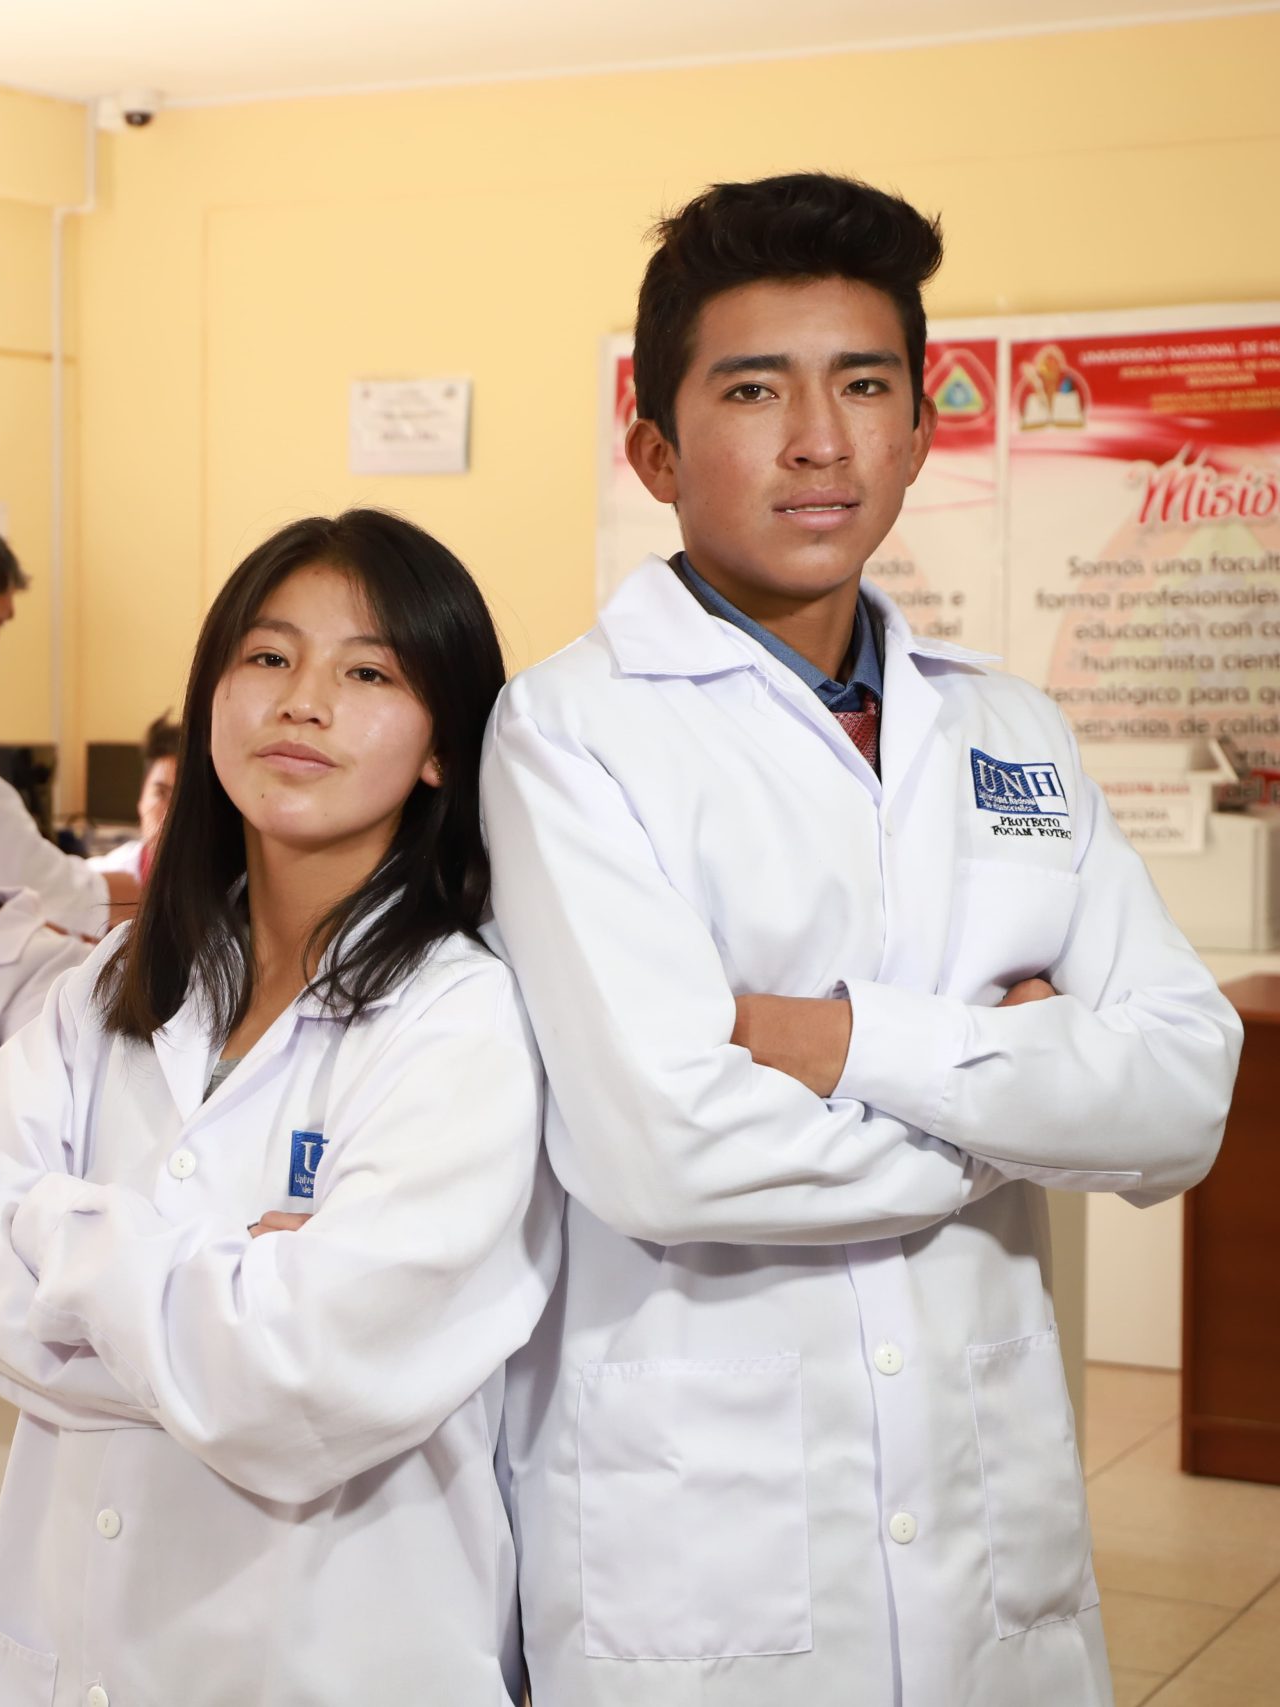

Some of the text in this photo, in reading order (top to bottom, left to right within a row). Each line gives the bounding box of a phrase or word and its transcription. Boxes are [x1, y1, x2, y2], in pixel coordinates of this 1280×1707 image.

[1067, 556, 1145, 578] Somos
[1153, 557, 1202, 575] una
[1035, 585, 1279, 611] forma profesionales
[1075, 615, 1201, 640] educación
[1209, 620, 1253, 638] con
[1081, 653, 1214, 673] humanista
[1189, 686, 1250, 707] para
[1179, 713, 1210, 735] de
[977, 759, 1062, 798] UNH
[999, 815, 1061, 828] PROYECTO
[991, 825, 1073, 841] FOCAM FOTEC
